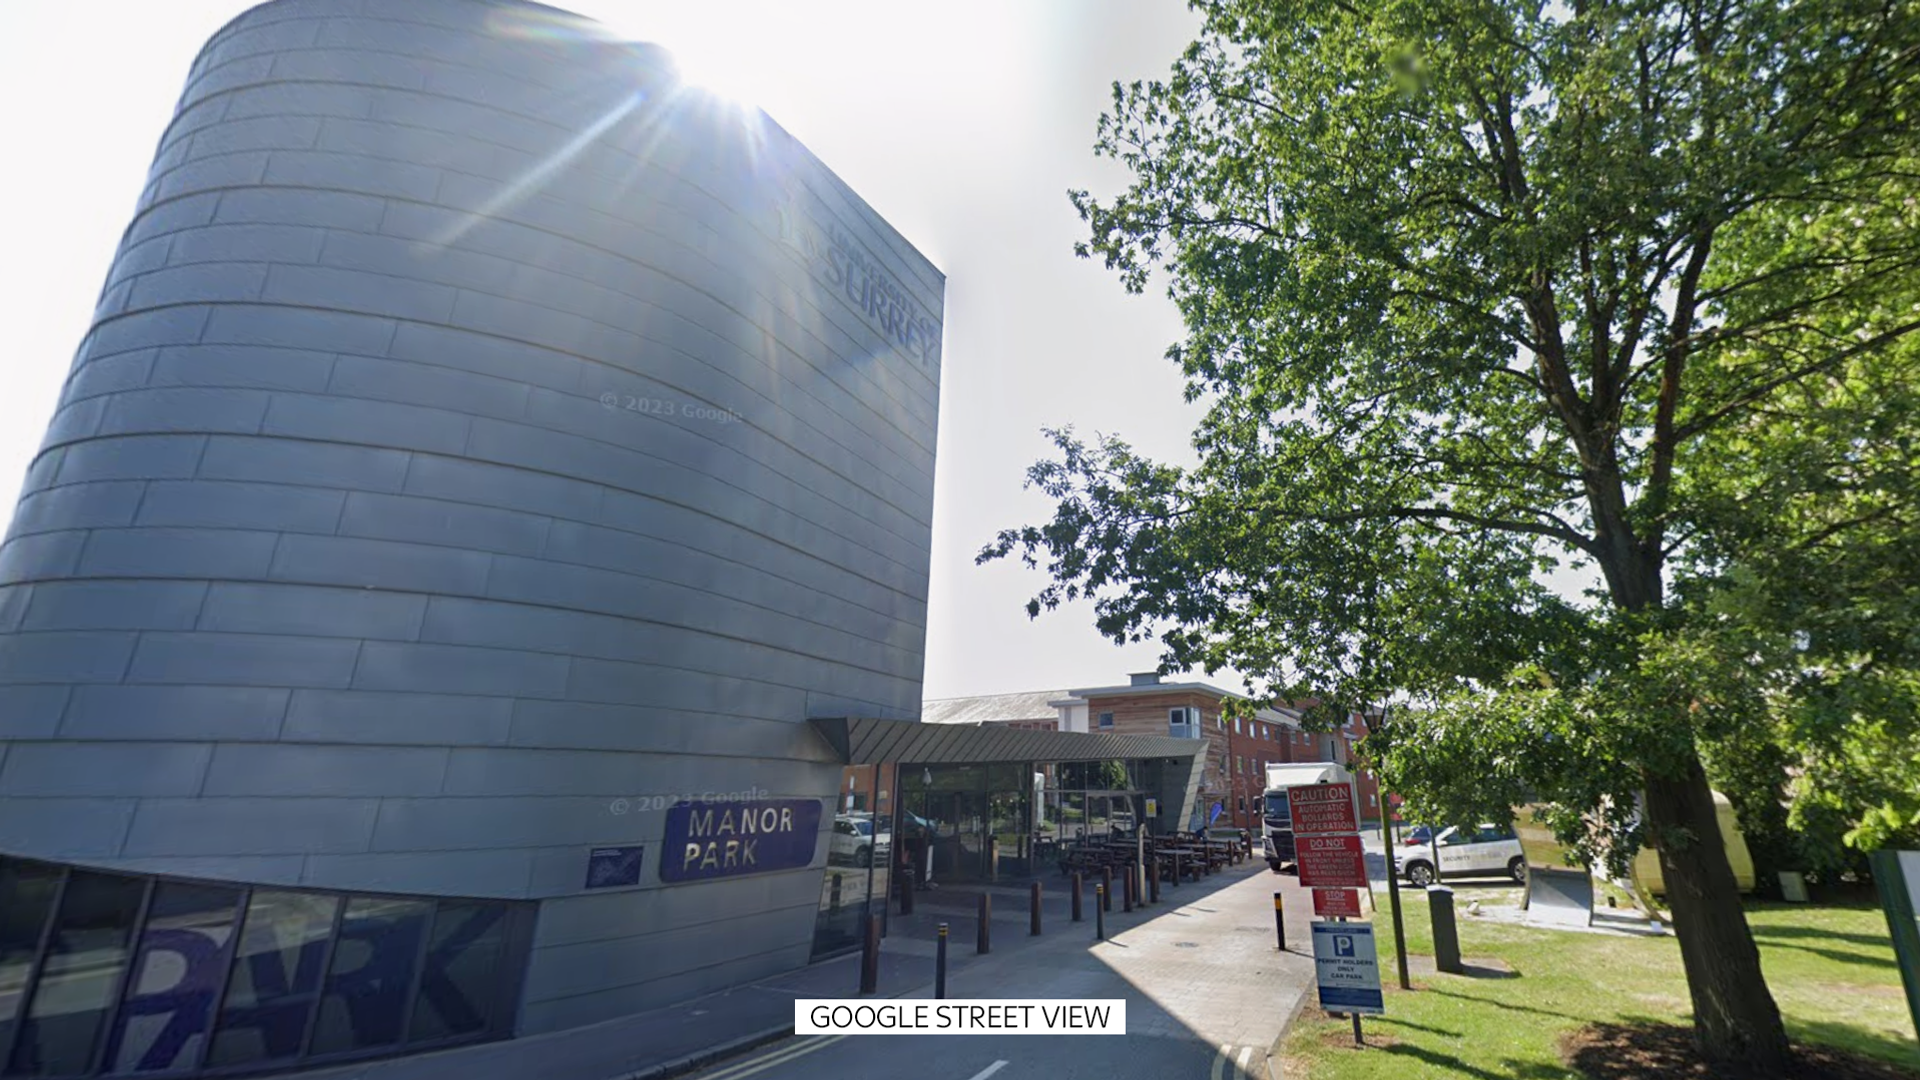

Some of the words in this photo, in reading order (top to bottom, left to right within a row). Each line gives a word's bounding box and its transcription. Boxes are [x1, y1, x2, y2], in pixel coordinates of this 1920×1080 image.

[823, 245, 937, 366] SURREY
[1291, 787, 1349, 801] CAUTION
[1298, 803, 1346, 814] AUTOMATIC
[688, 807, 794, 838] MANOR
[1302, 812, 1345, 822] BOLLARDS
[1294, 823, 1305, 832] IN
[1306, 821, 1354, 831] OPERATION
[1310, 838, 1324, 848] DO
[1326, 838, 1346, 848] NOT
[684, 839, 759, 872] PARK
[1325, 890, 1346, 899] STOP
[1336, 935, 1351, 955] P
[1317, 957, 1341, 965] PERMIT
